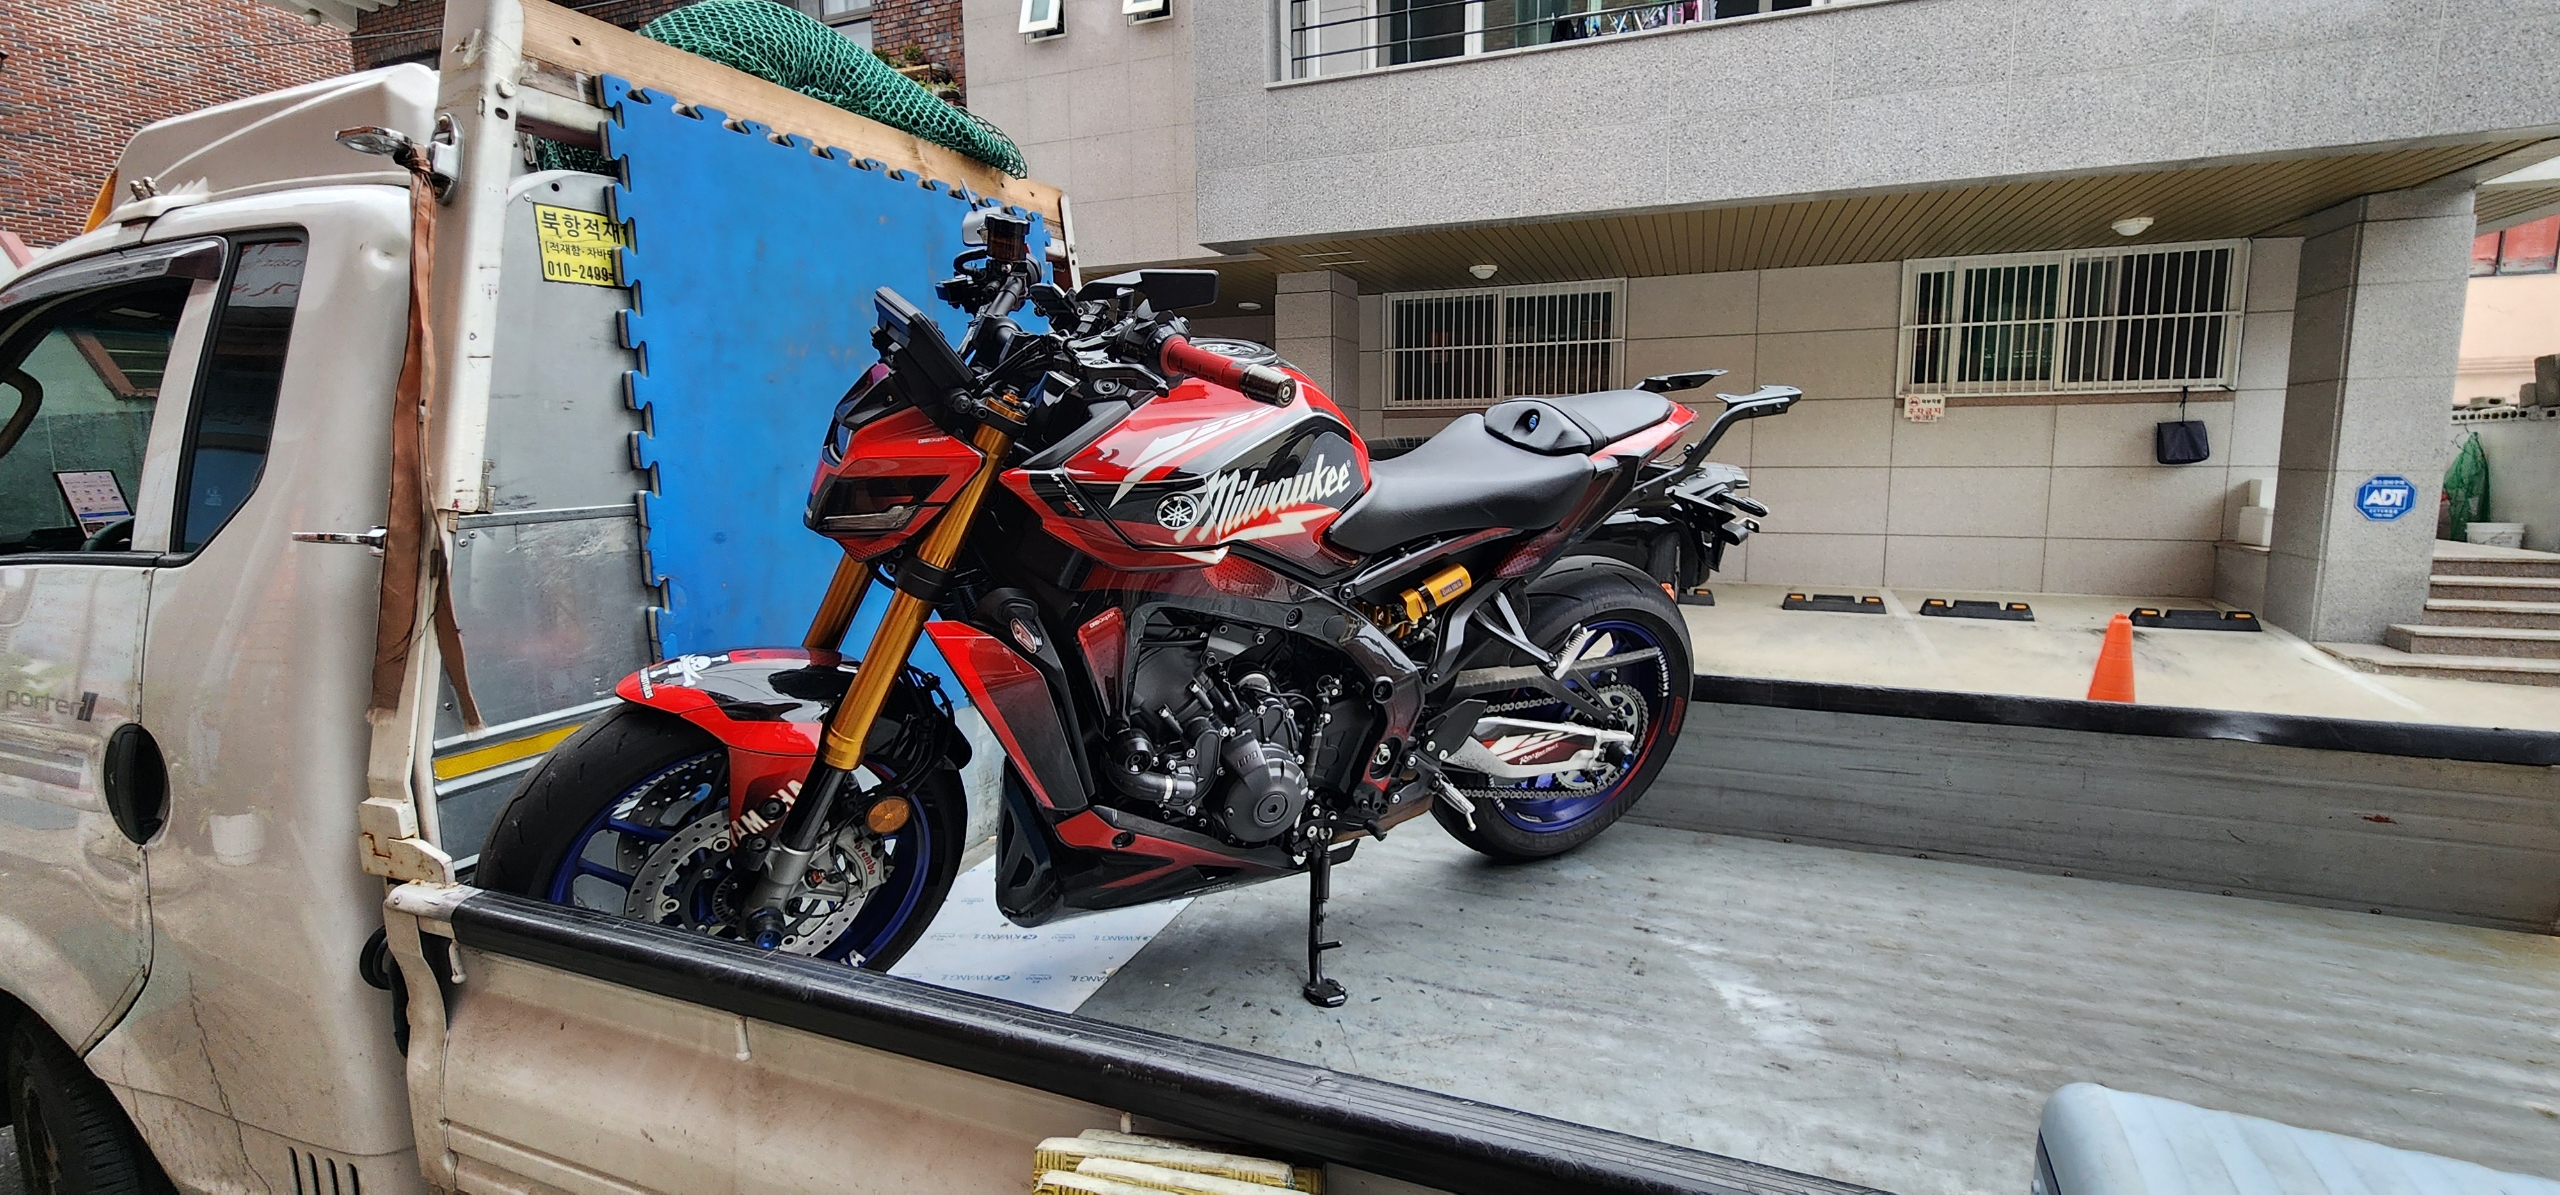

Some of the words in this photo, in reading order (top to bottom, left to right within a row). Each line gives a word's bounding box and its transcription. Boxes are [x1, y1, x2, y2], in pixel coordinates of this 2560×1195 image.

[541, 210, 627, 244] 북항적재
[1049, 471, 1086, 511] MT-09
[1173, 453, 1351, 544] Milwaukee
[2365, 488, 2408, 506] ADT
[853, 841, 876, 876] brembo
